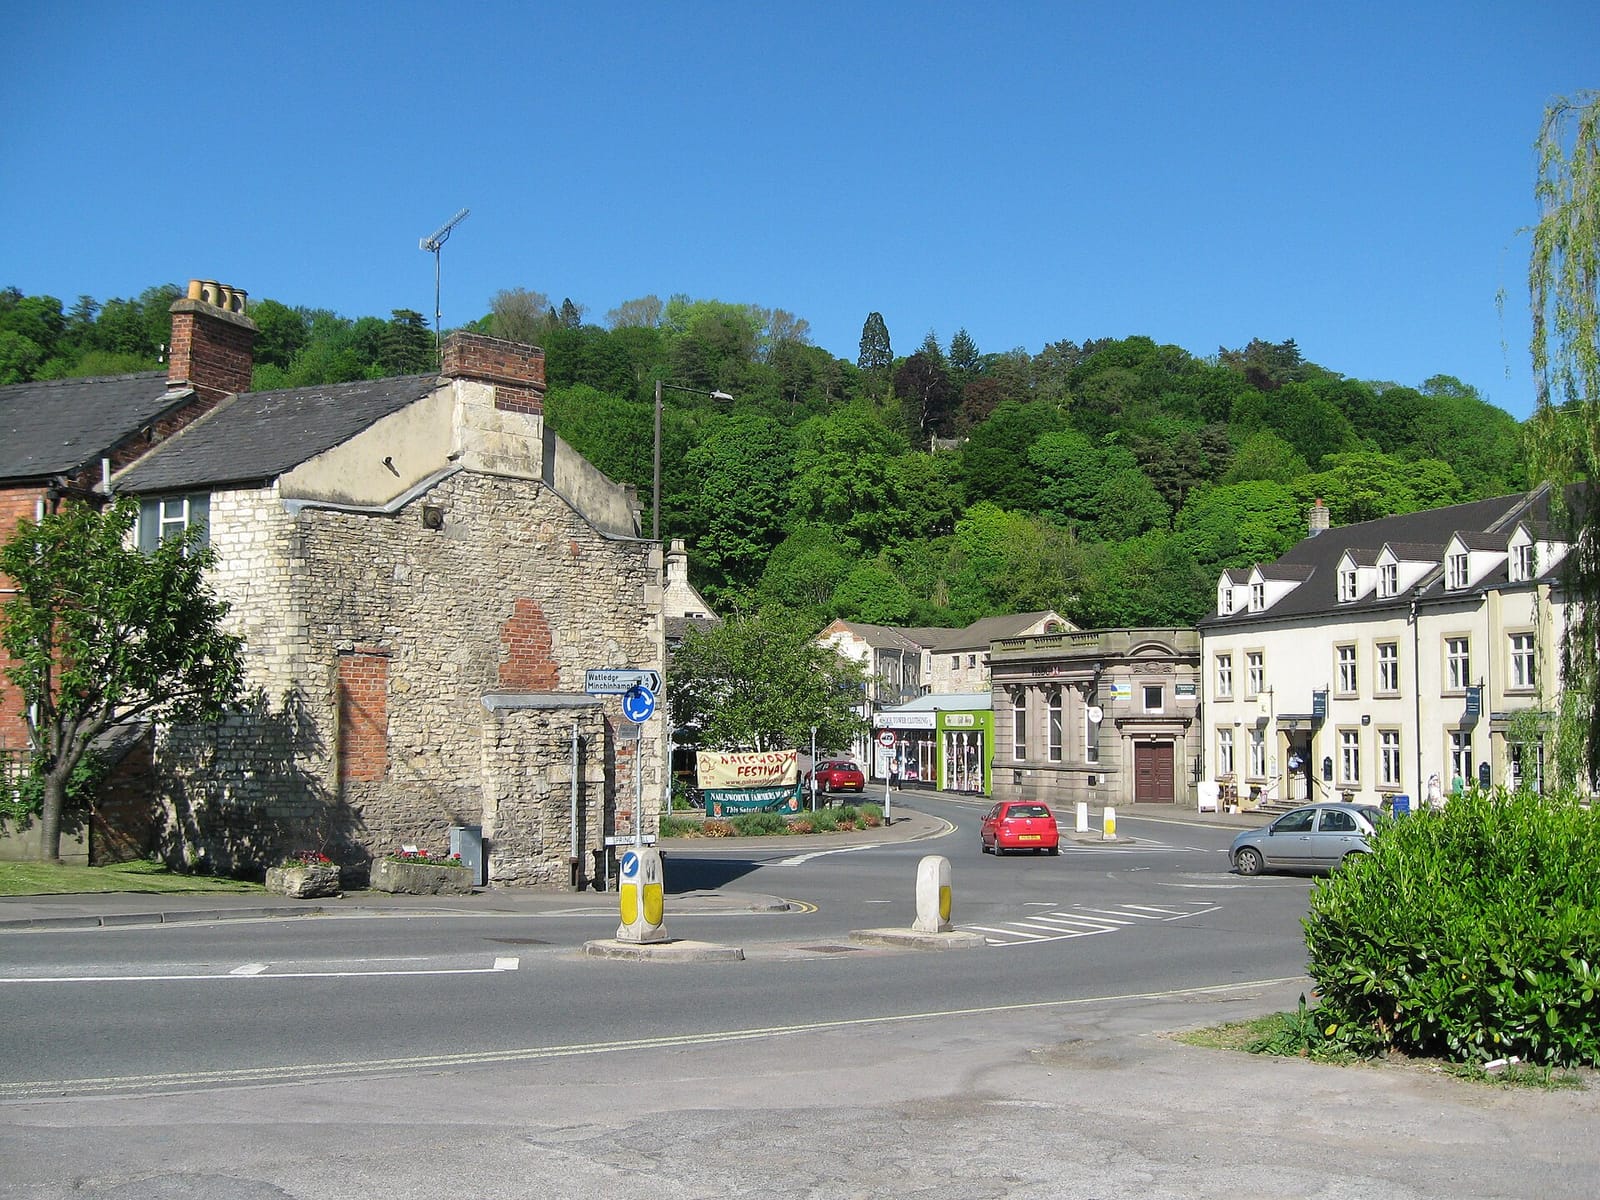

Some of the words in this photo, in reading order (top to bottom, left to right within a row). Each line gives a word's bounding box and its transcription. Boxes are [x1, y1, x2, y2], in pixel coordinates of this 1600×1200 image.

[588, 673, 618, 682] Watledge
[737, 765, 785, 777] FESTIVAL
[710, 792, 750, 802] NAILSWORTH
[726, 806, 738, 814] This
